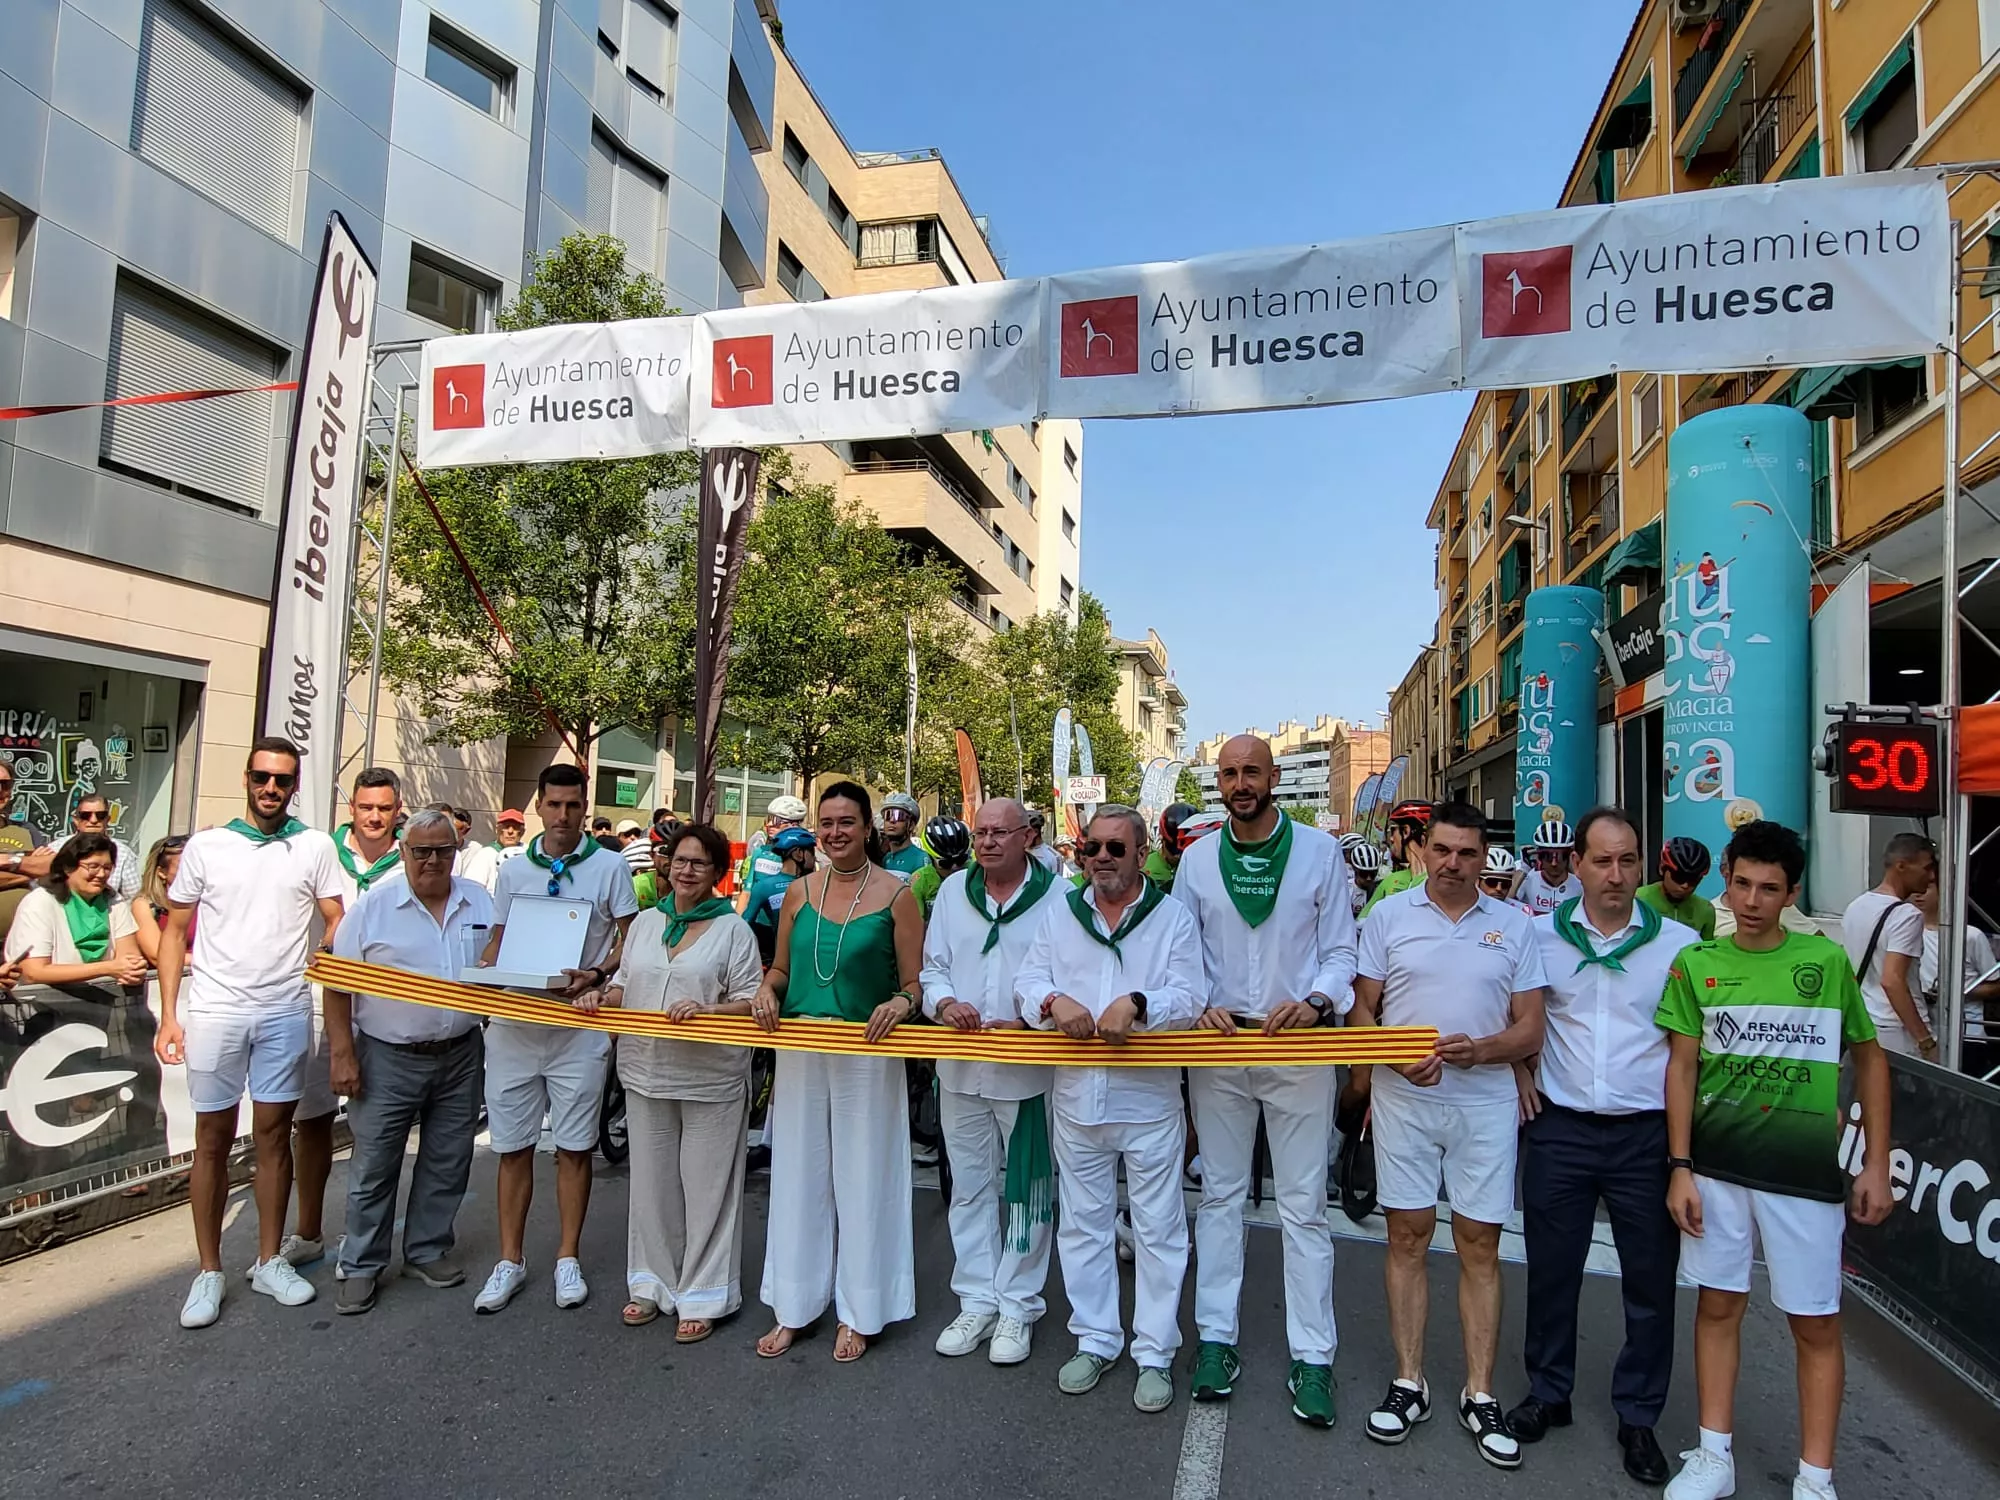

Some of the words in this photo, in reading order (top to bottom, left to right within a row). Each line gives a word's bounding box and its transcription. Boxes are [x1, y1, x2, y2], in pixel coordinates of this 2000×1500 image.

[1587, 220, 1920, 285] Ayuntamiento
[1151, 273, 1438, 333] Ayuntamiento
[1586, 291, 1636, 328] de
[1655, 281, 1834, 323] Huesca
[784, 319, 1023, 370] Ayuntamiento
[1151, 339, 1194, 373] de
[1211, 330, 1364, 368] Huesca
[492, 350, 681, 396] Ayuntamiento
[783, 374, 819, 403] de
[833, 369, 960, 401] Huesca
[493, 399, 519, 427] de
[530, 395, 633, 423] Huesca
[1848, 739, 1928, 792] 30
[1231, 873, 1276, 884] Fundación
[1233, 883, 1275, 897] Ibercaja
[1739, 1032, 1827, 1046] AUTOCUATRO
[1748, 1021, 1817, 1034] RENAULT
[1721, 1058, 1813, 1084] Huesca
